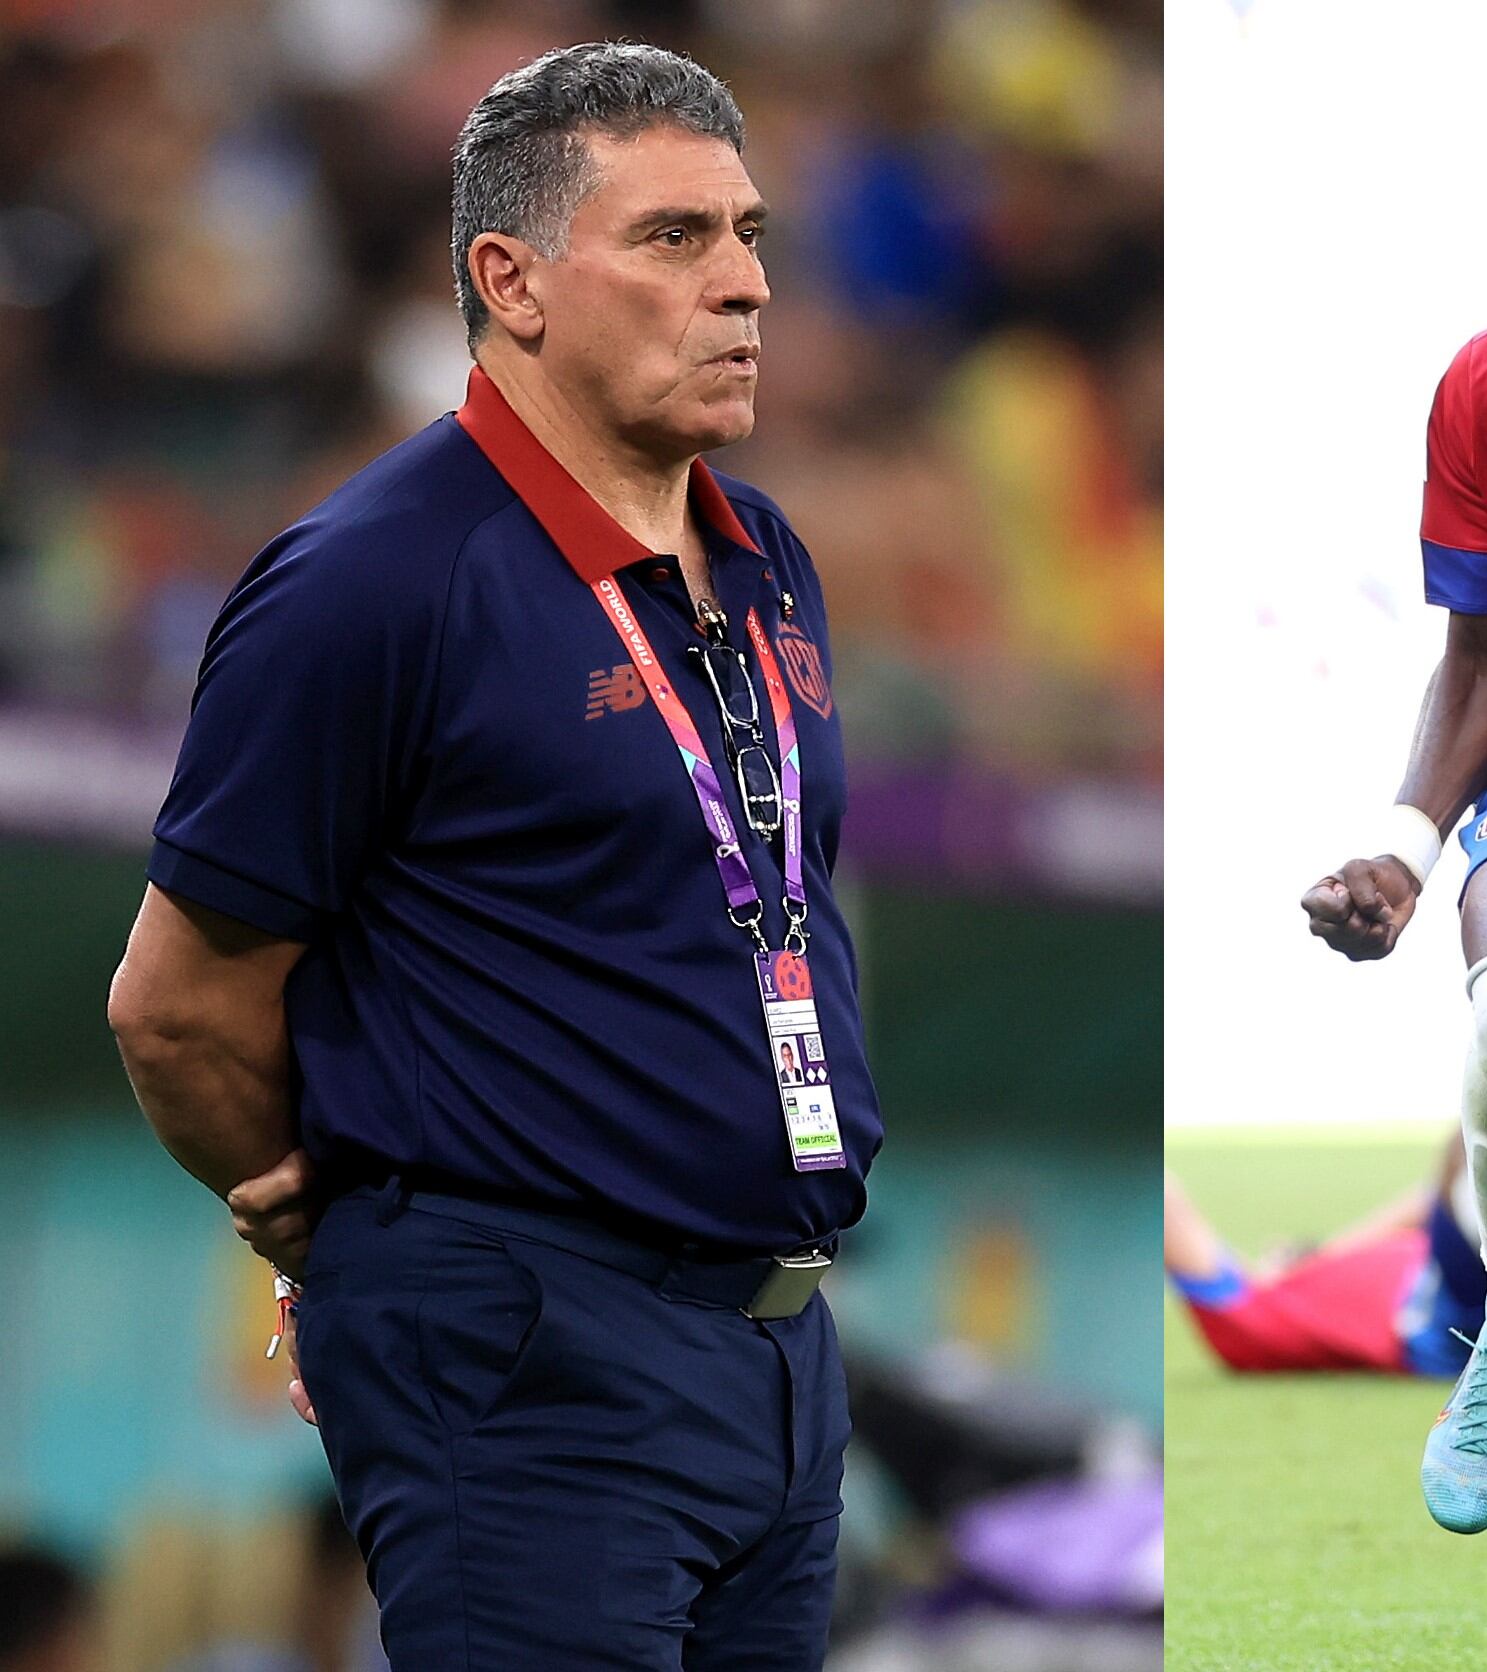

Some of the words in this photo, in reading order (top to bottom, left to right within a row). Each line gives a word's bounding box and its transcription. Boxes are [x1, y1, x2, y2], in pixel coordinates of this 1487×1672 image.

[599, 579, 635, 635] WORLD
[629, 632, 654, 667] FIFA
[810, 1134, 837, 1144] OFFICIAL
